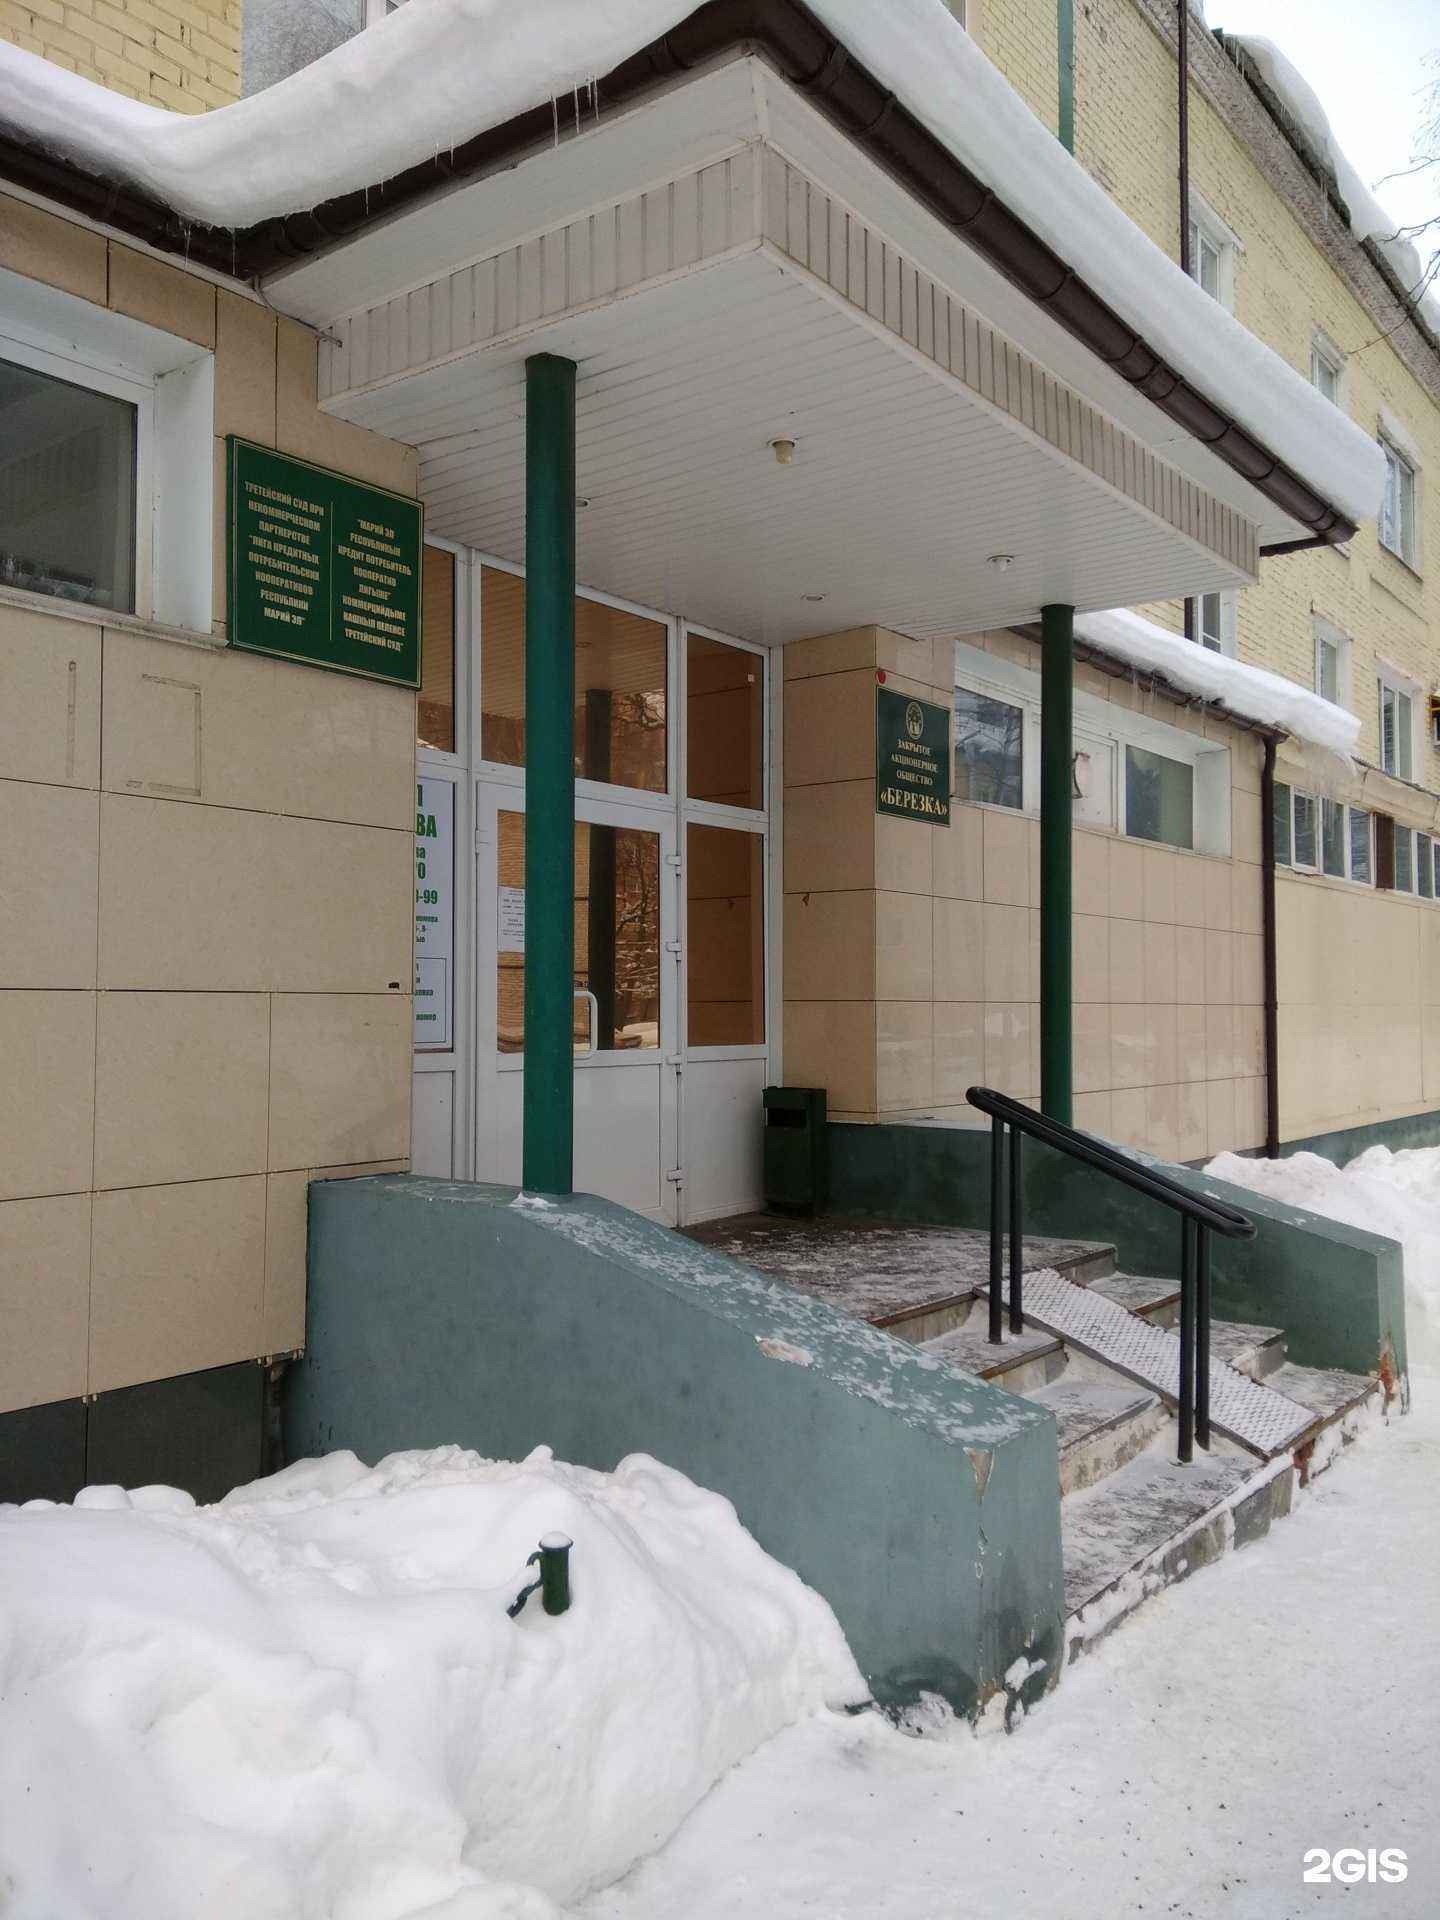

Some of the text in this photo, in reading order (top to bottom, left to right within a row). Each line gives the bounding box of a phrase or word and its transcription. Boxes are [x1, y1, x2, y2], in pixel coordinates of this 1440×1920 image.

[244, 480, 325, 517] ТРЕТЕЙСКИЙ СУД ПРИ
[248, 500, 321, 532] НЕКОММЕРЧЕСКОМ
[259, 521, 311, 545] ПАРТНЕРСТВЕ
[273, 542, 320, 564] КРЕДИТНЫХ
[337, 544, 412, 576] КРЕДИТ ПОТРЕБИТЕЛЬ
[248, 552, 320, 582] ПОТРЕБИТЕЛЬСКИХ
[353, 566, 397, 588] КООПЕРАТИВ
[255, 571, 314, 596] КООПЕРАТИВОВ
[260, 589, 309, 611] РЕСПУБЛИКИ
[264, 607, 291, 623] МАРИЙ
[345, 628, 387, 648] ТРЕТЕЙСКИЙ
[896, 739, 931, 756] ЗАКРЫТОЕ
[889, 753, 938, 773] АКЦИОНЕРНОЕ
[896, 769, 933, 786] ОБЩЕСТВО
[880, 787, 948, 816] «БЕРЕЗКА»
[416, 813, 438, 838] ВА
